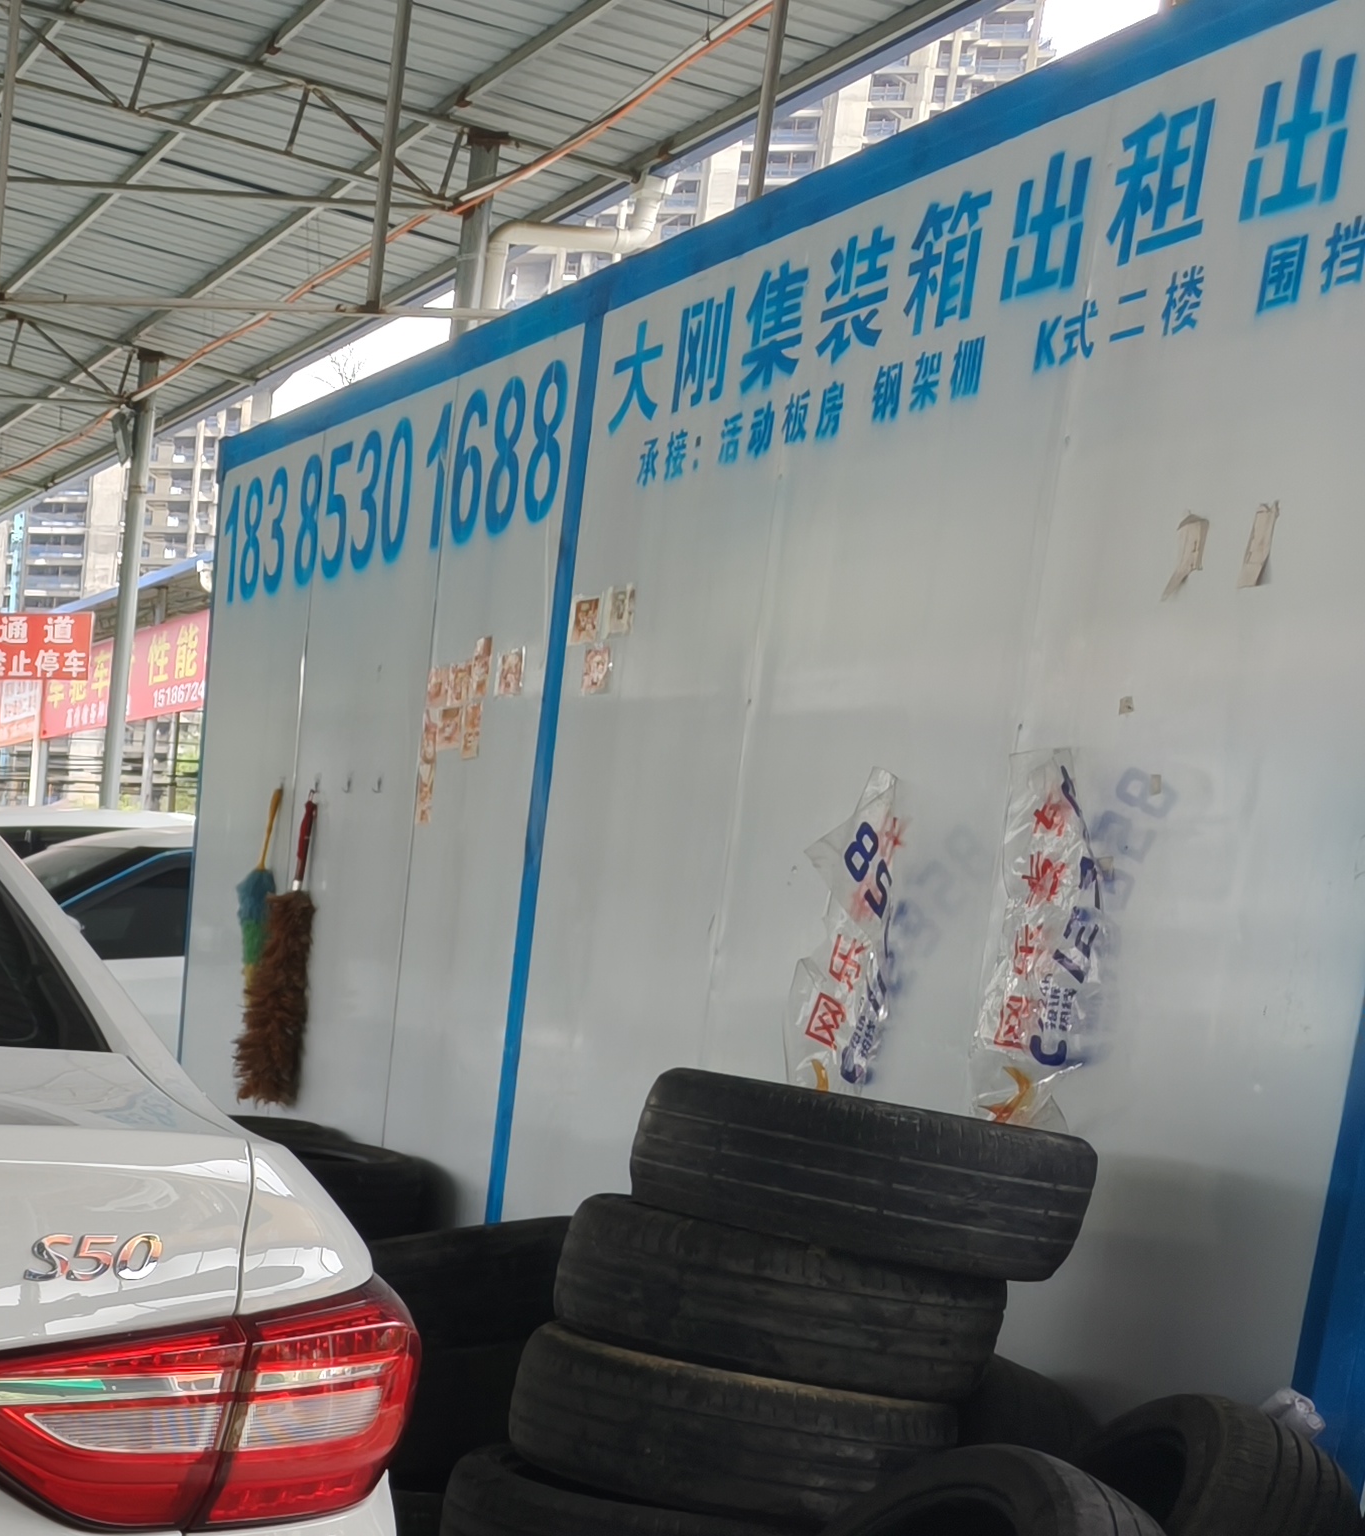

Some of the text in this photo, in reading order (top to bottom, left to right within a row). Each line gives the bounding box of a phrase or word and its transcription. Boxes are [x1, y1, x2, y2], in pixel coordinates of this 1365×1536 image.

[607, 48, 1359, 437] 大刚集装箱出租出
[1033, 264, 1206, 373] K式二楼
[23, 1232, 163, 1282] S50
